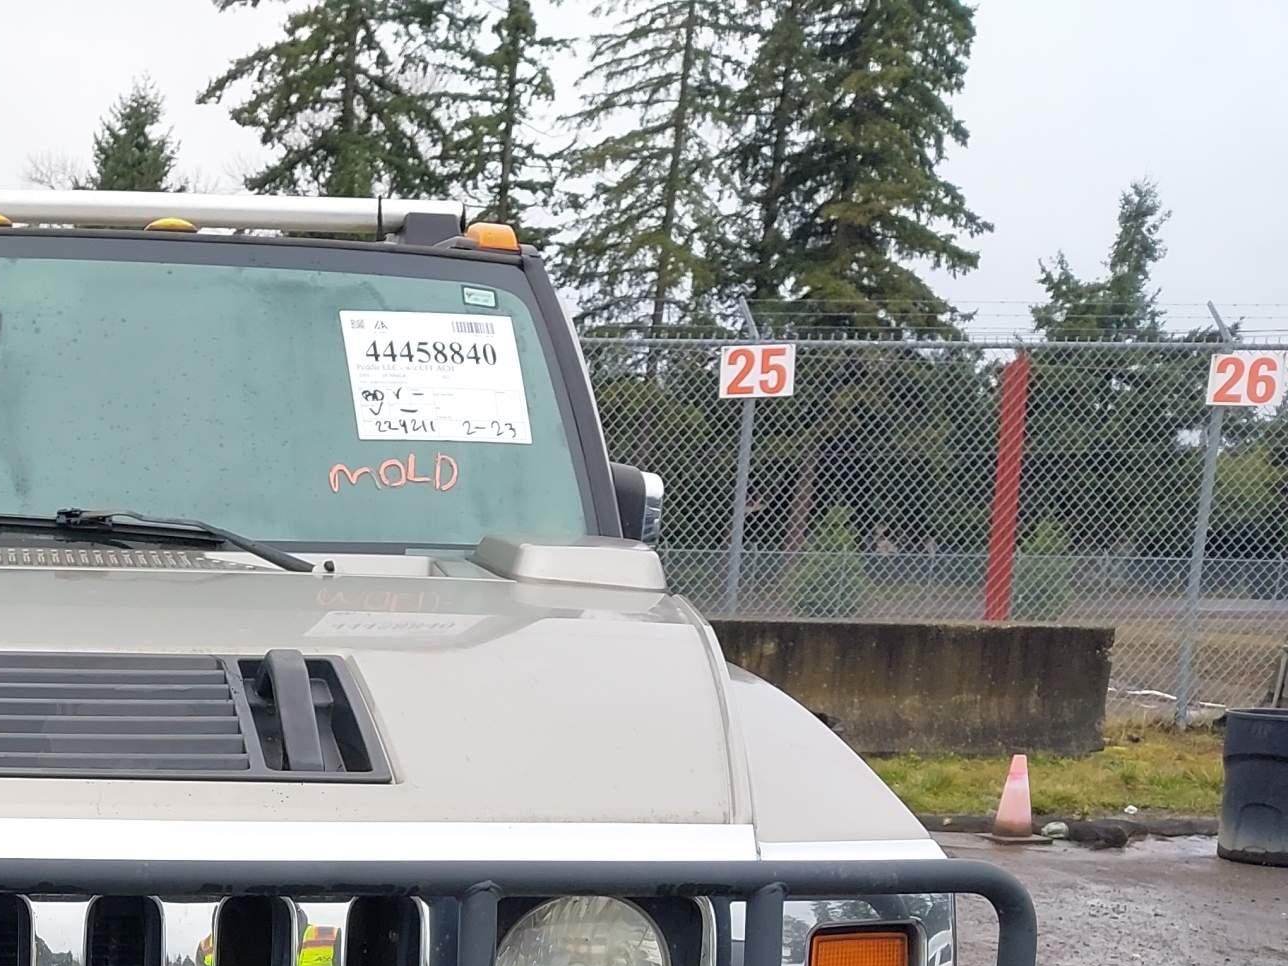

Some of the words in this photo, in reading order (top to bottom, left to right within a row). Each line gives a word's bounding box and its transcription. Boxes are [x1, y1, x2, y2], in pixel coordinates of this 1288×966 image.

[366, 340, 497, 365] 44458840
[727, 348, 786, 394] 25
[1213, 357, 1277, 404] 26
[329, 452, 459, 493] MOLD
